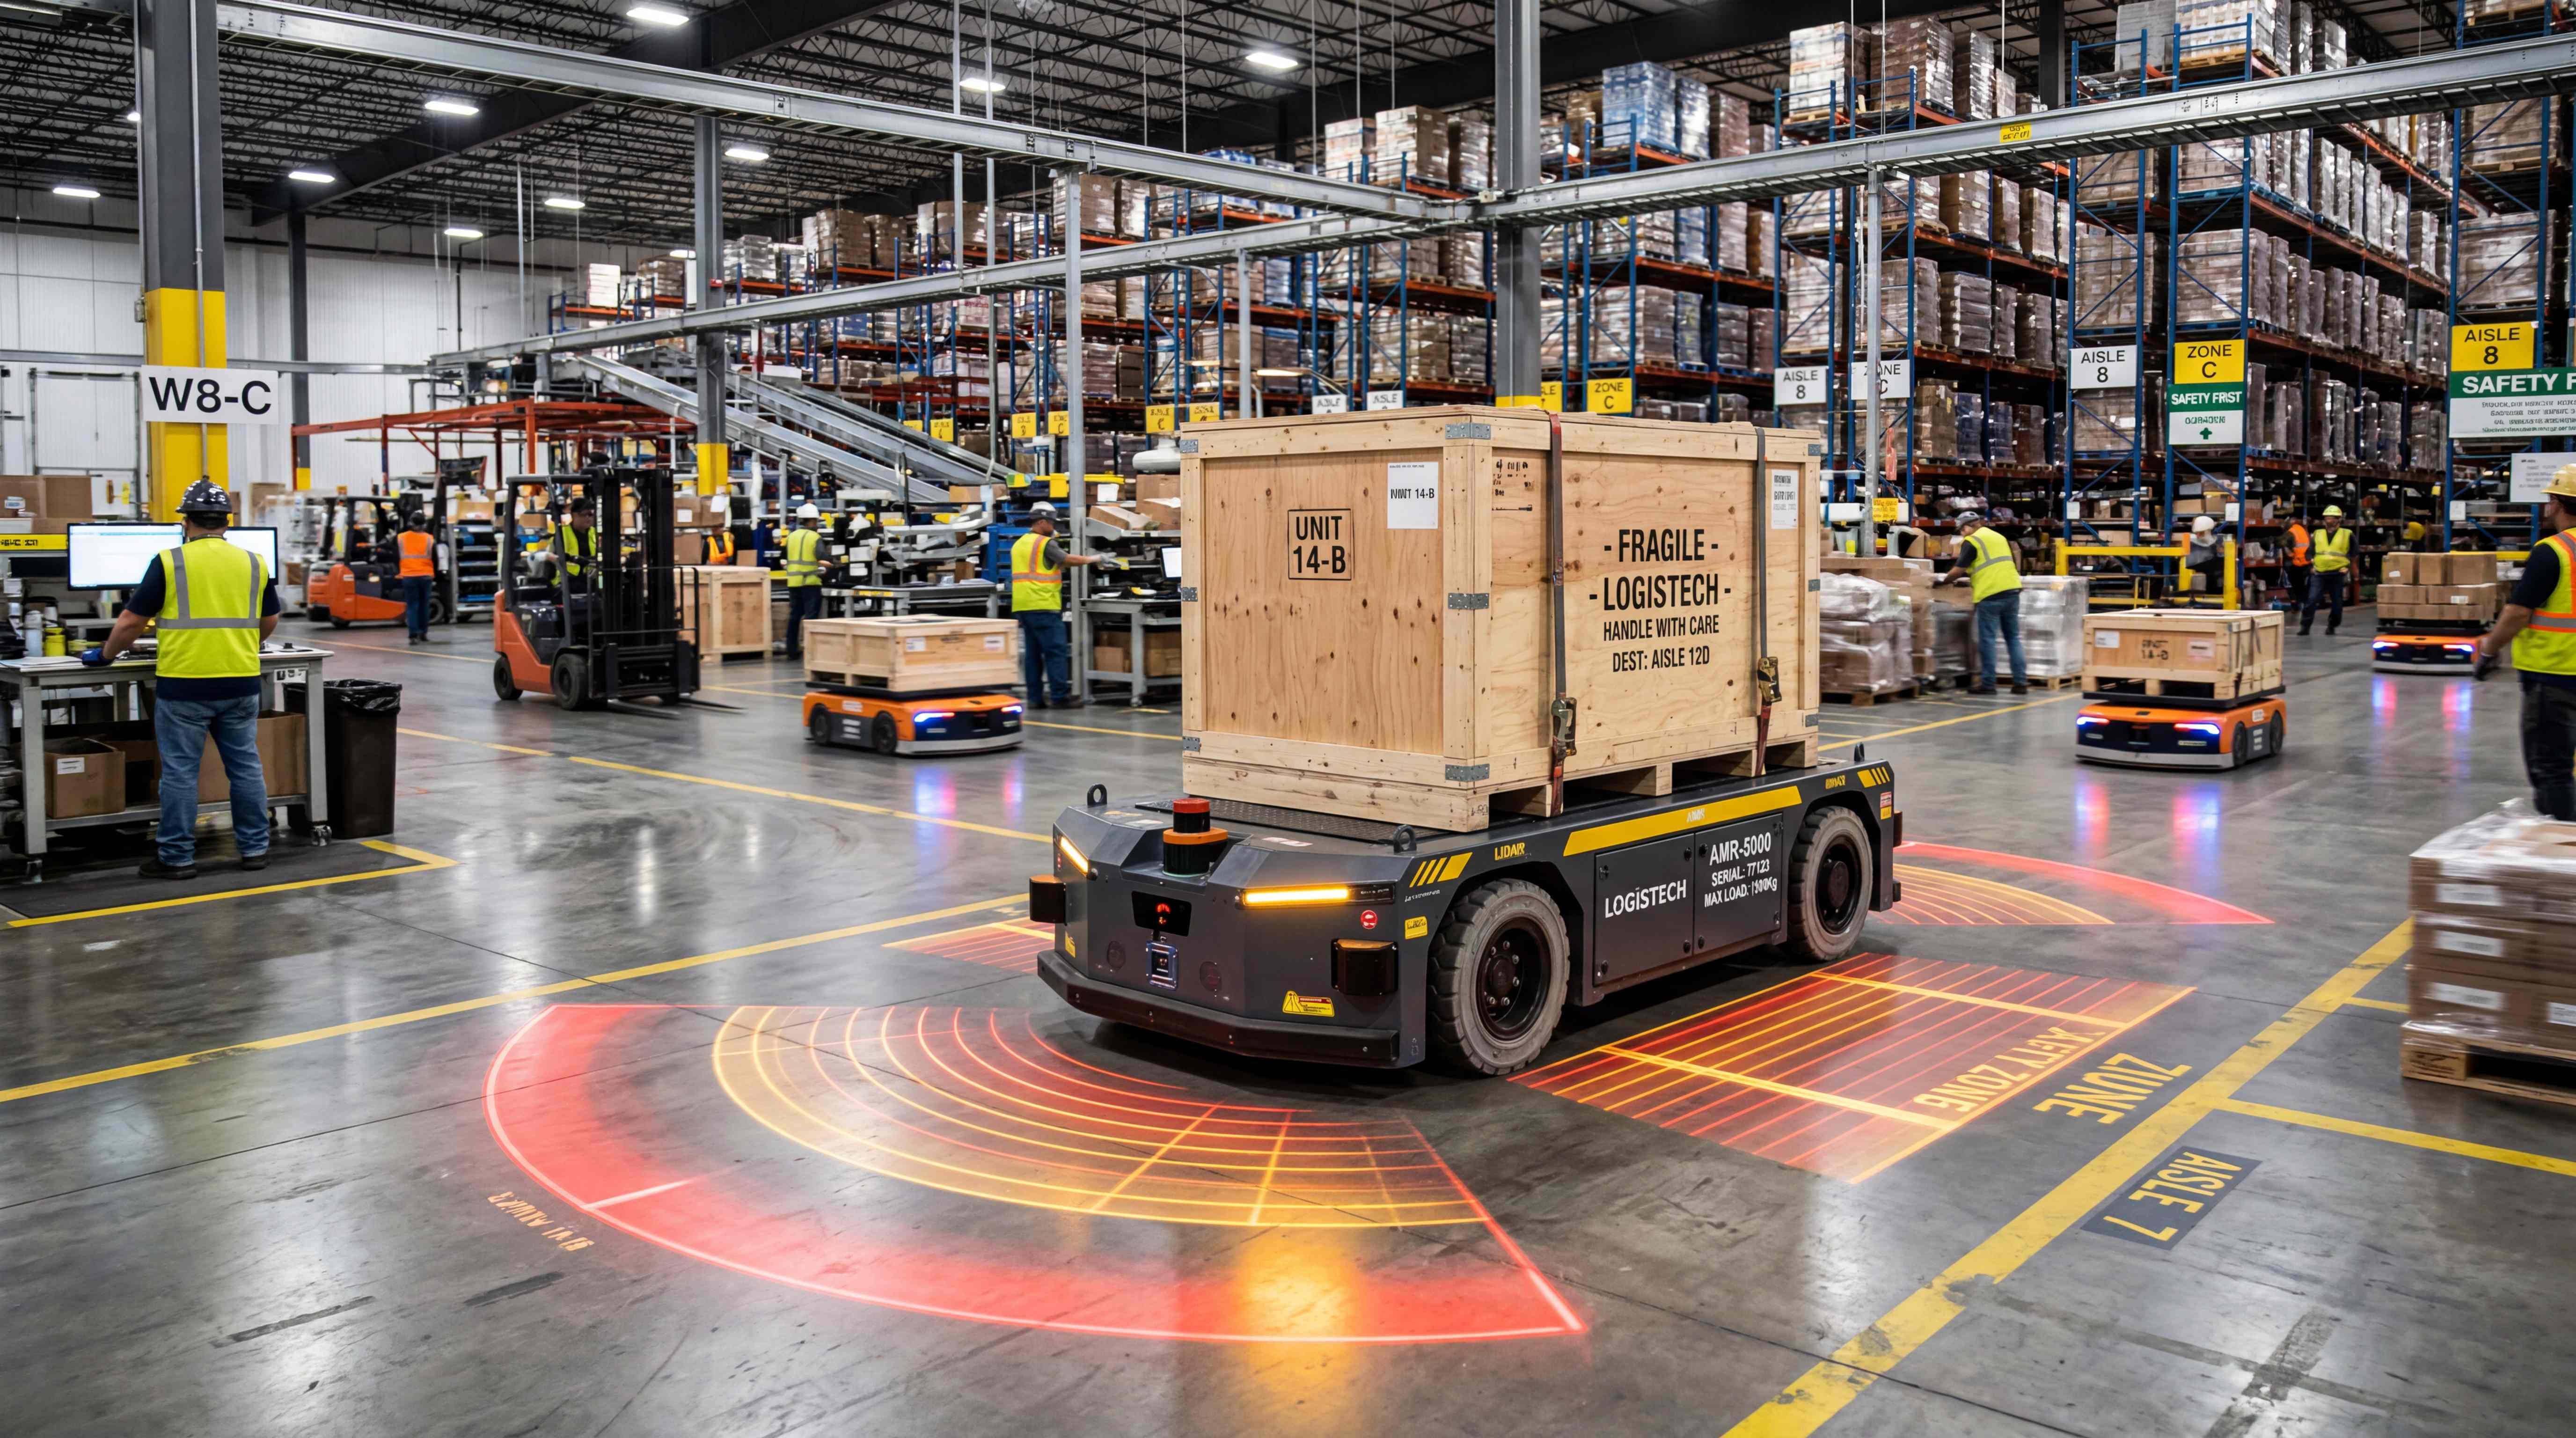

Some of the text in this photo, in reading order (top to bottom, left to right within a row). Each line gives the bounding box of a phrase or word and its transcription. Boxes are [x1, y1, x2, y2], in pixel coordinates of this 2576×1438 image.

[2465, 327, 2520, 342] AISLE
[2081, 350, 2125, 364] AISLE
[2187, 344, 2232, 358] ZONE
[2483, 346, 2499, 365] 8
[1783, 370, 1818, 382] AISLE
[2097, 367, 2108, 383] 8
[2202, 361, 2217, 378] C
[1796, 384, 1806, 399] 8
[2462, 373, 2559, 394] SAFETY
[149, 376, 271, 415] W8-C
[1604, 396, 1614, 409] C
[2171, 392, 2210, 405] SAFETY
[1296, 516, 1342, 541] UNIT
[1293, 545, 1346, 574] 14-B
[1603, 615, 1719, 641] HANDLE WITH CARE
[1612, 645, 1711, 672] DEST: AISLE 12D
[1709, 832, 1771, 866] AMR-5000
[1712, 866, 1745, 887] SERIAL:
[1704, 890, 1723, 908] MAX
[2103, 1151, 2242, 1241] AISLE 7
